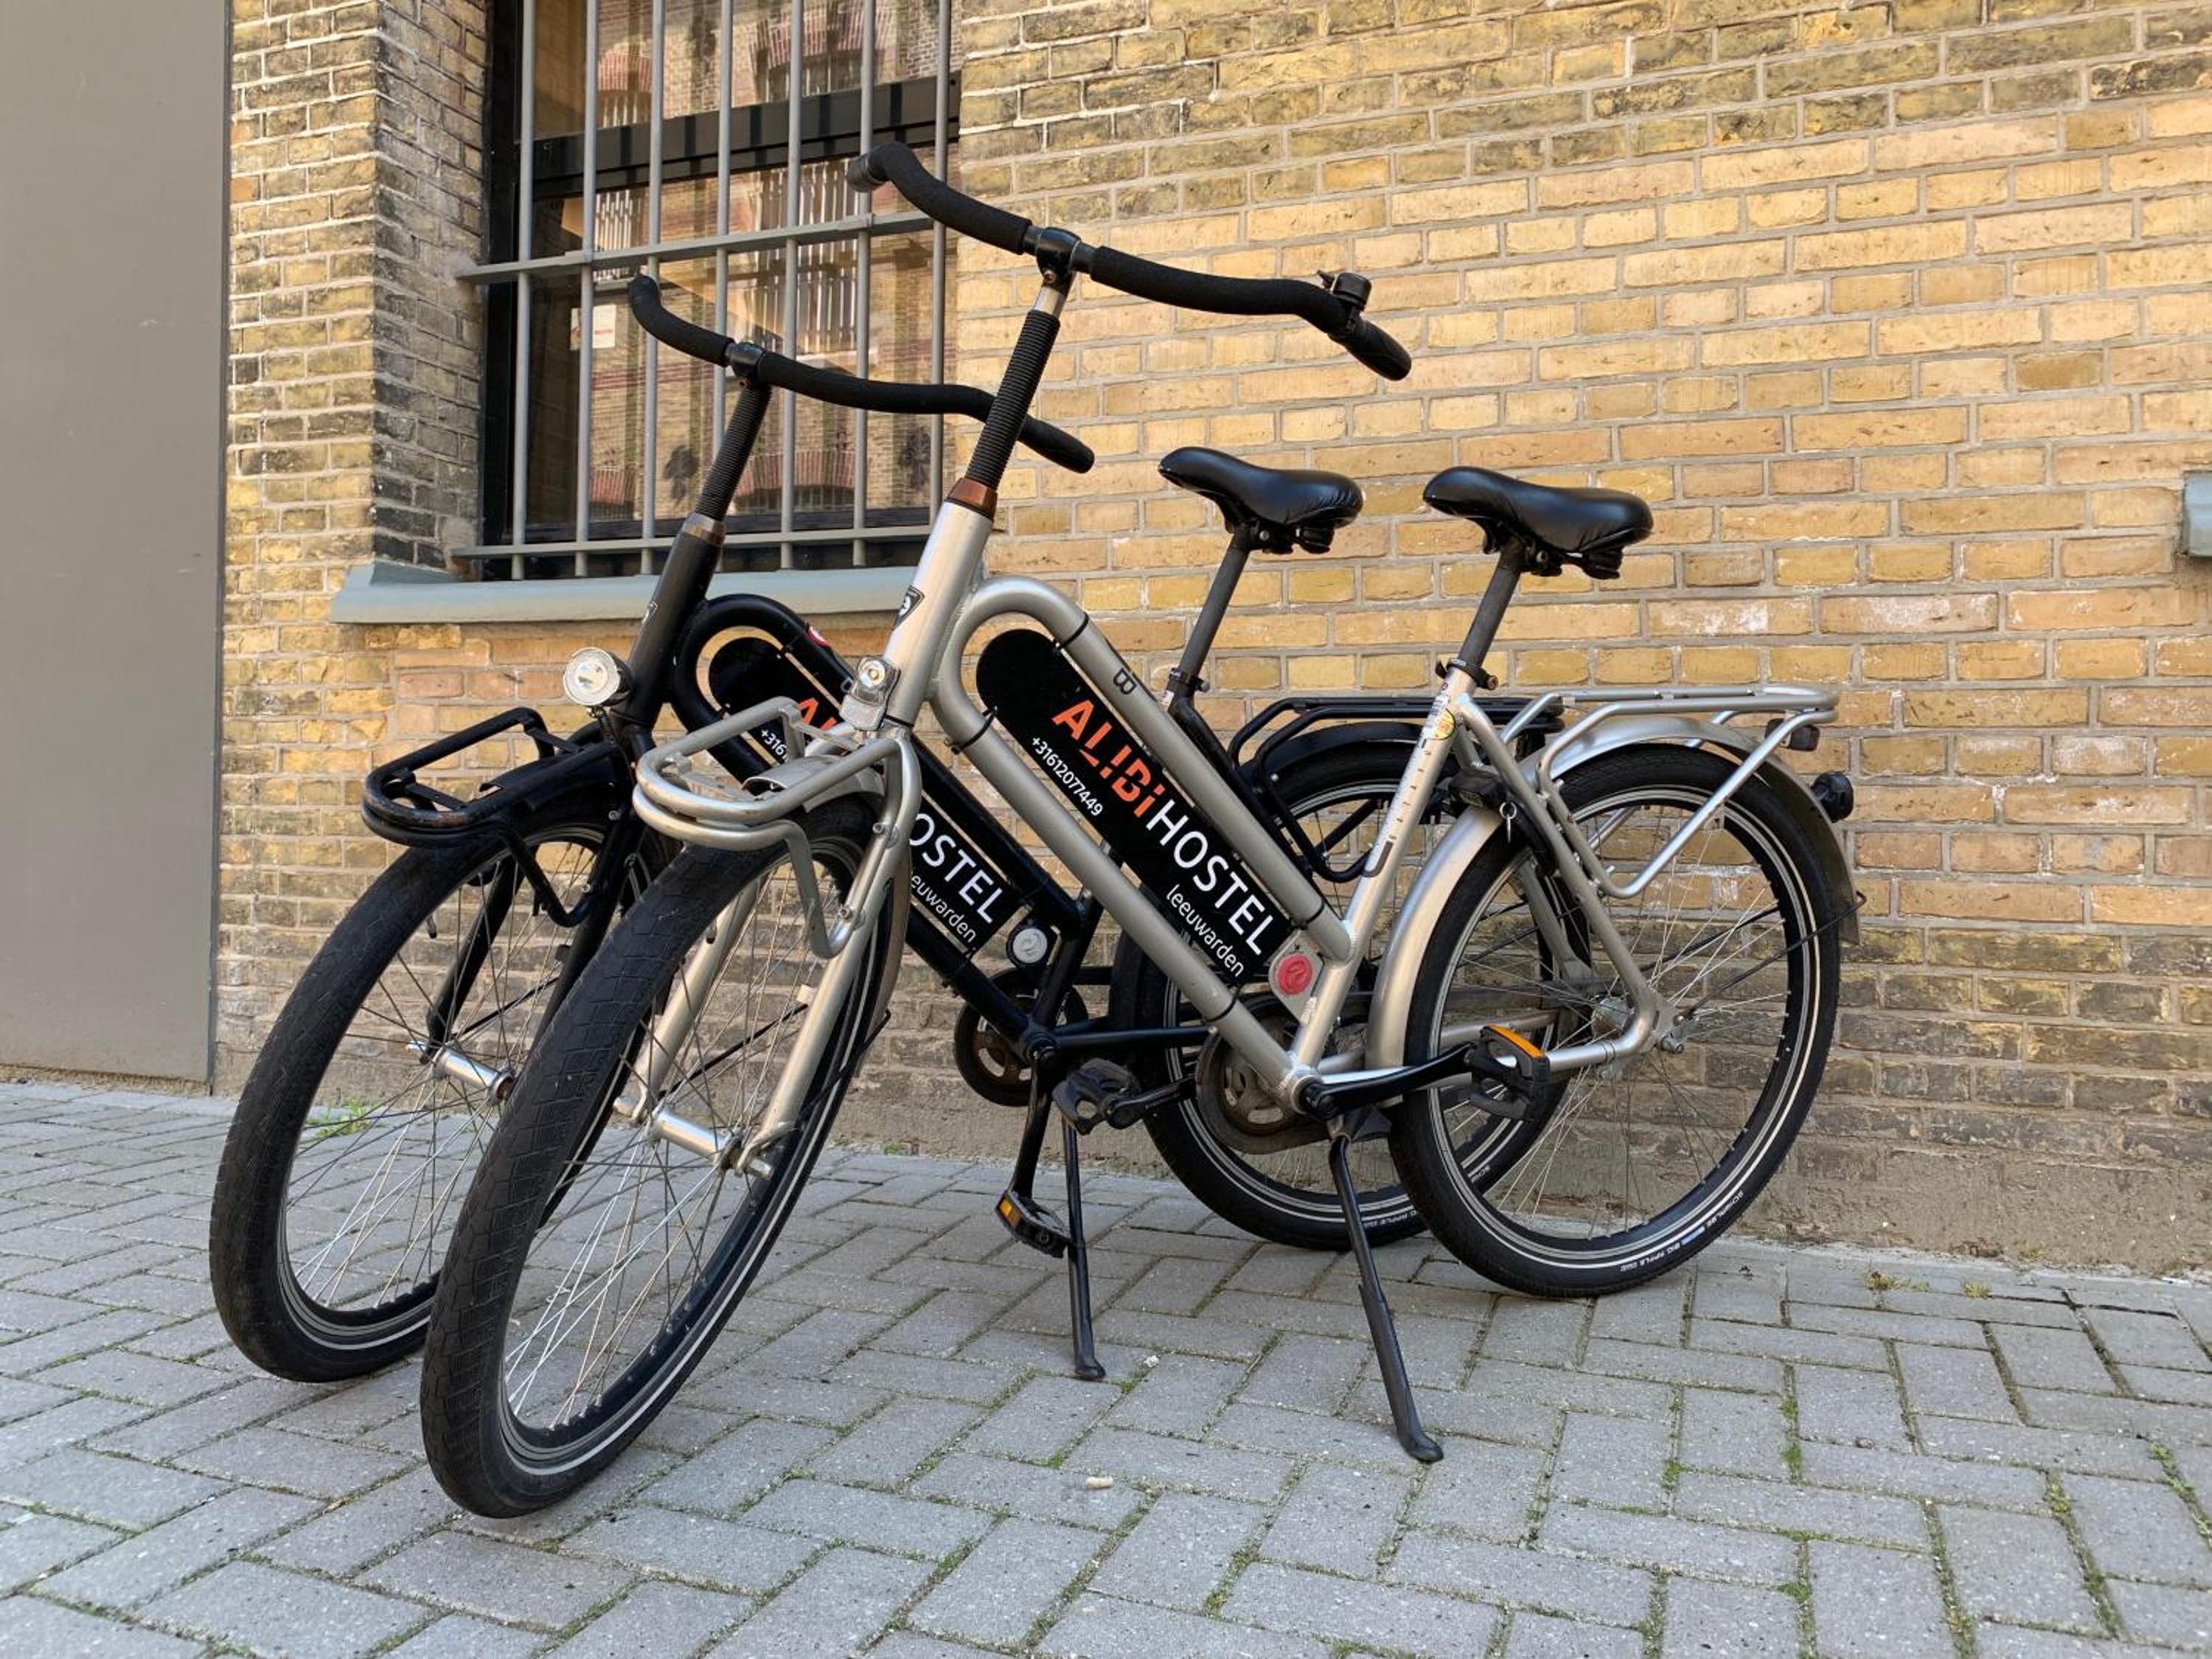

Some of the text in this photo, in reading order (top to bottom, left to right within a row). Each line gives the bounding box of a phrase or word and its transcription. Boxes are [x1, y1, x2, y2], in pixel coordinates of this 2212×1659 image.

[1032, 737, 1103, 816] +31612077449
[909, 813, 1003, 924] OSTEL
[911, 874, 977, 943] euwarden
[1146, 799, 1273, 956] HOSTEL
[1166, 884, 1245, 977] leeuwarden
